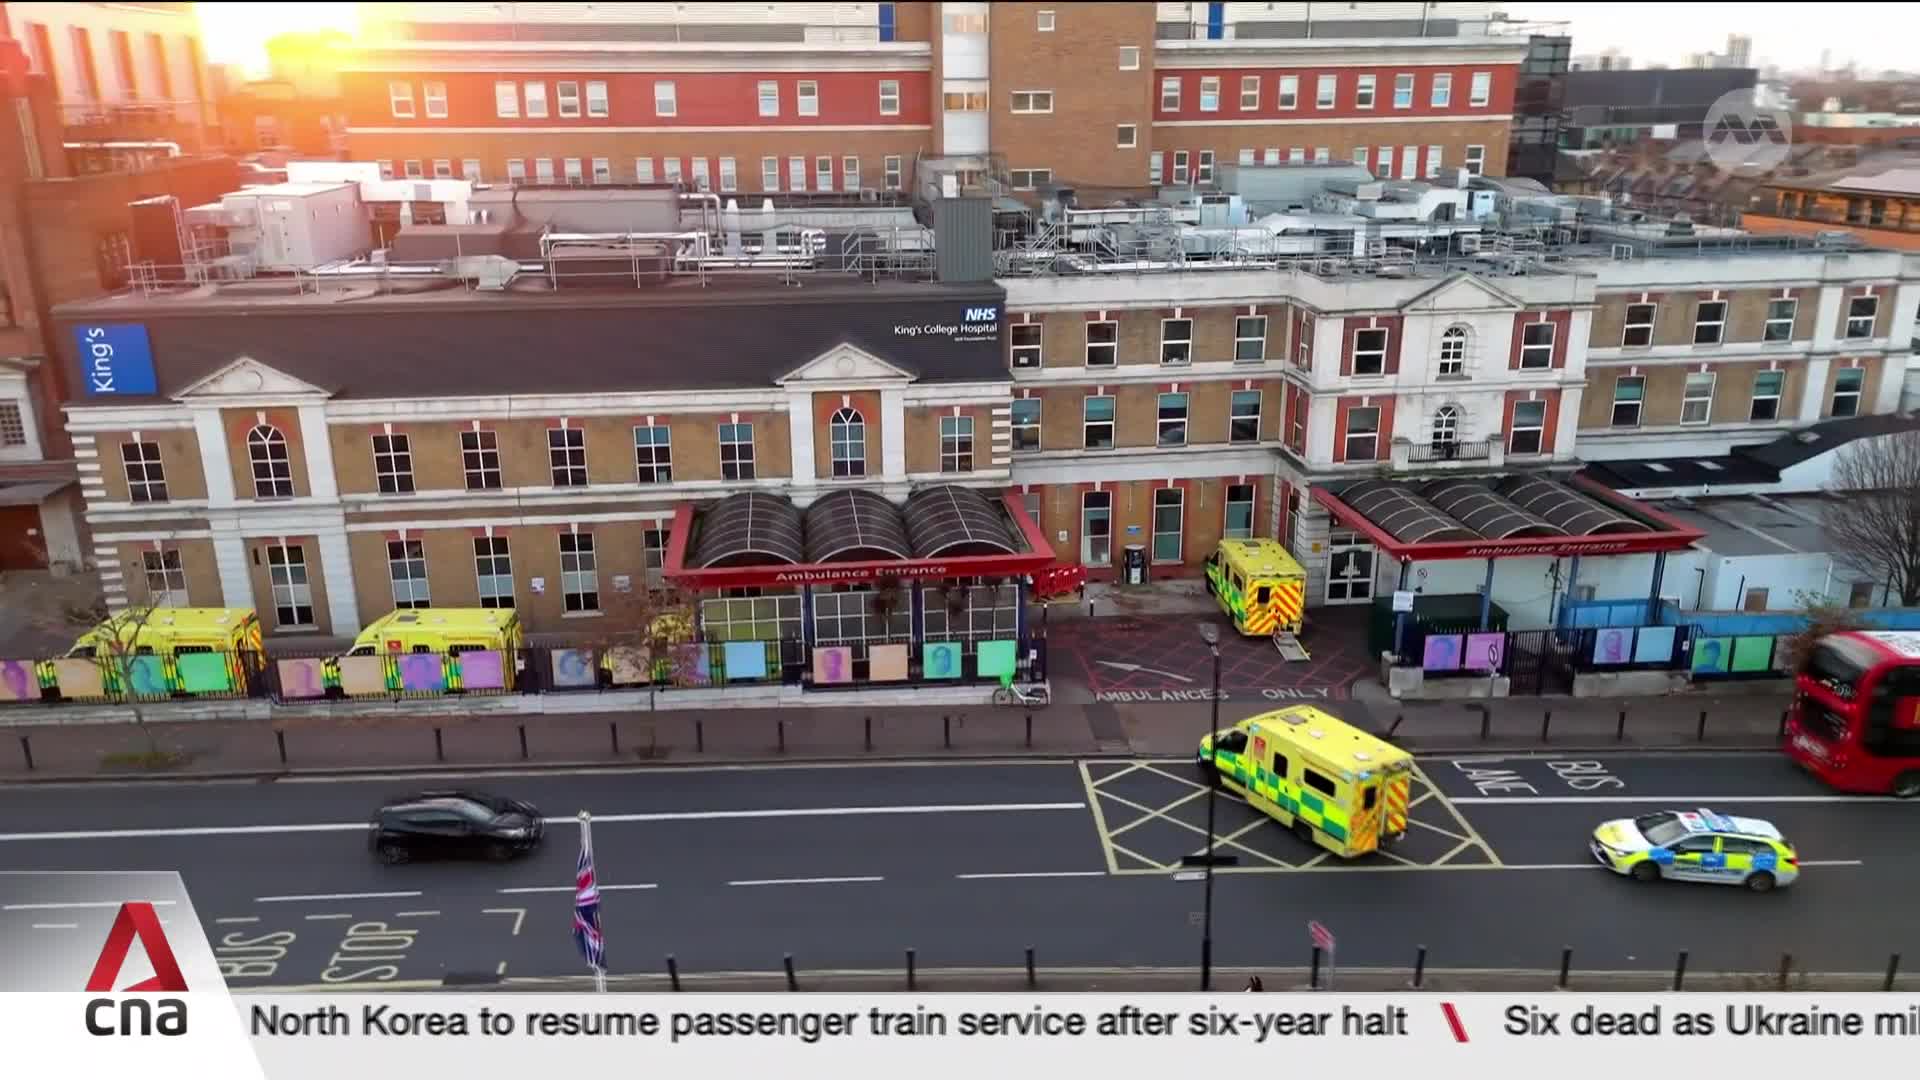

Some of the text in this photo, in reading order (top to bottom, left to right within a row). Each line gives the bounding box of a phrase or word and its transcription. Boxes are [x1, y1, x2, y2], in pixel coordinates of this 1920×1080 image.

[894, 322, 998, 337] King's College Hospital
[965, 308, 997, 321] NHS
[85, 328, 116, 392] King's
[775, 566, 947, 582] Ambulance Entrance
[1261, 687, 1329, 699] ONLY
[1451, 758, 1539, 796] LANE
[1545, 760, 1625, 790] BUS
[216, 931, 297, 977] BUS
[321, 922, 420, 982] STOP
